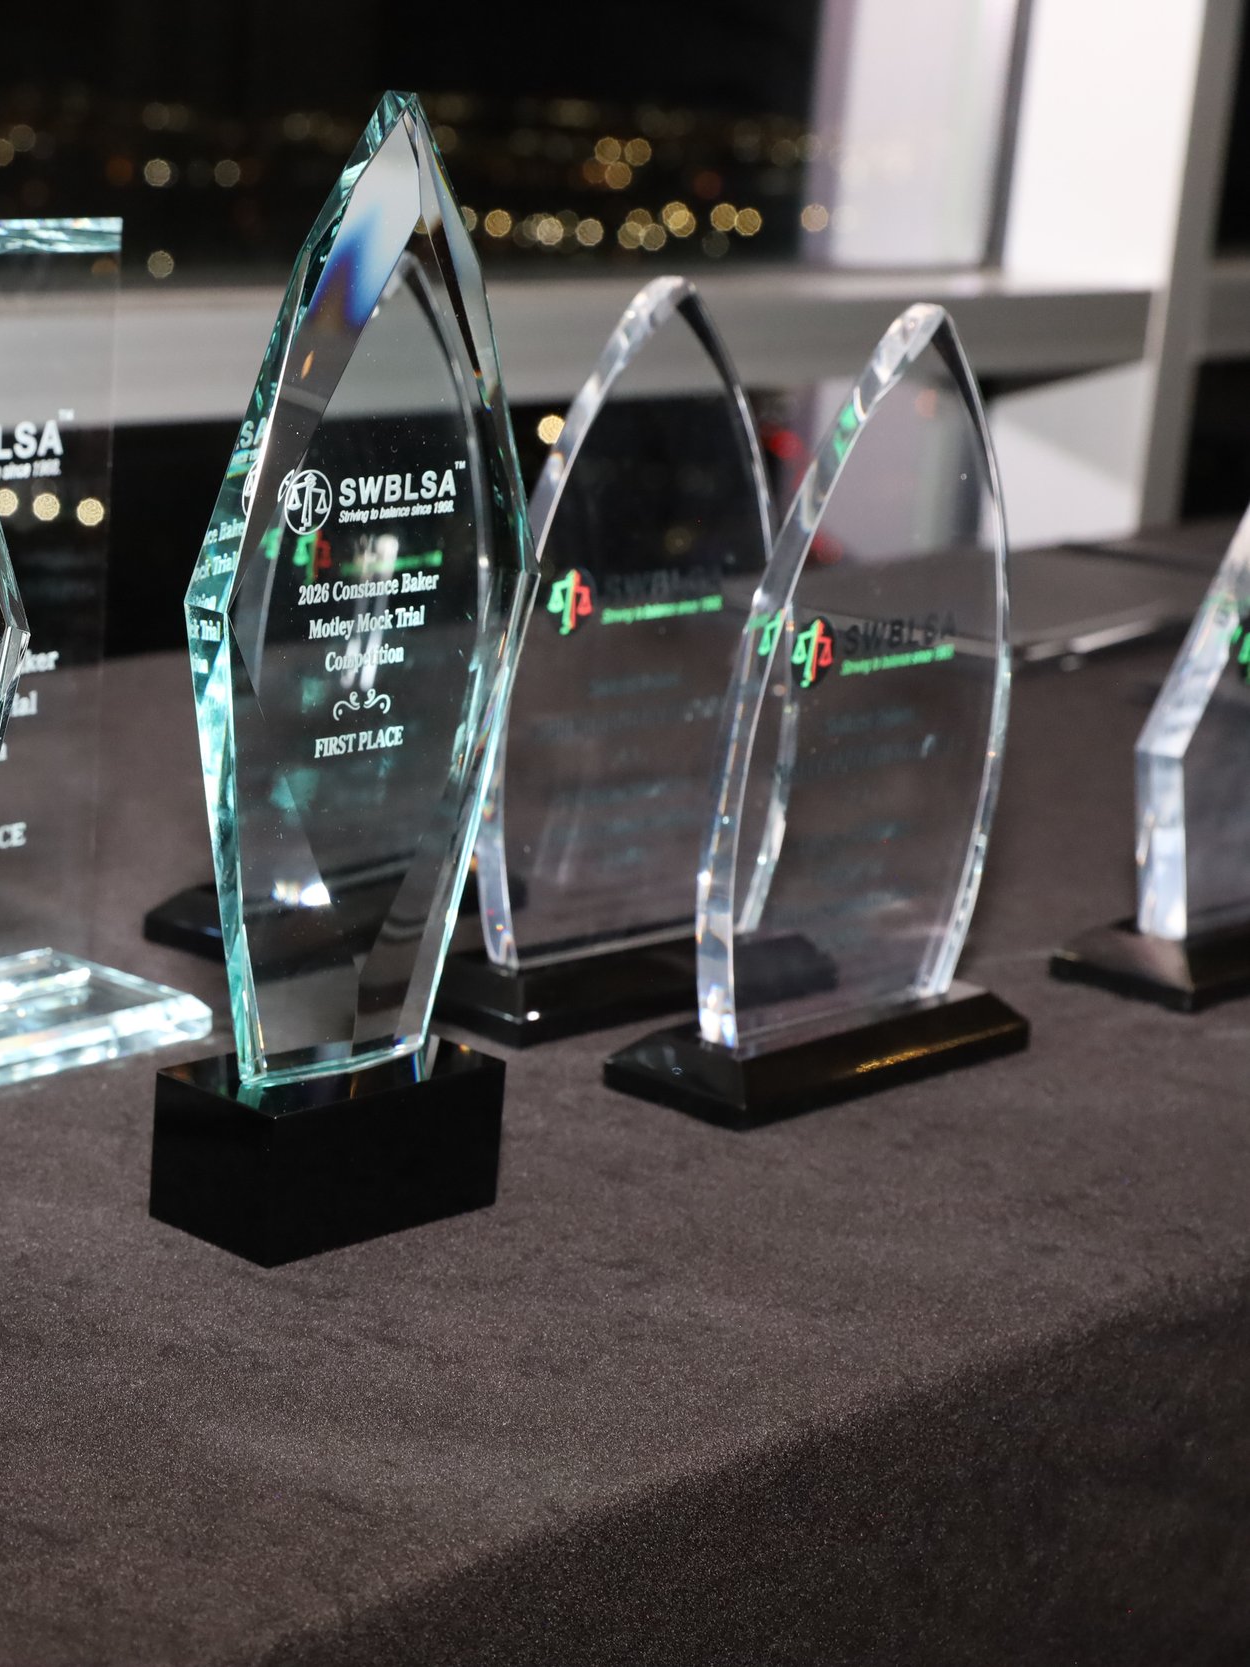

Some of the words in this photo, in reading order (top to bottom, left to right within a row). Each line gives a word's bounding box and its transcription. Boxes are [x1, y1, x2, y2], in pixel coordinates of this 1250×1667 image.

[338, 469, 456, 507] SWBLSA
[454, 461, 466, 470] TM
[338, 509, 369, 524] Striving
[370, 508, 379, 520] to
[411, 503, 432, 516] since
[298, 582, 330, 606] 2026
[332, 578, 399, 602] Constance
[401, 571, 440, 594] Baker
[308, 616, 355, 640] Motley
[356, 609, 395, 633] Mock
[395, 605, 426, 628] Trial
[325, 643, 404, 673] Competition
[314, 733, 356, 758] FIRST
[357, 725, 404, 752] PLACE
